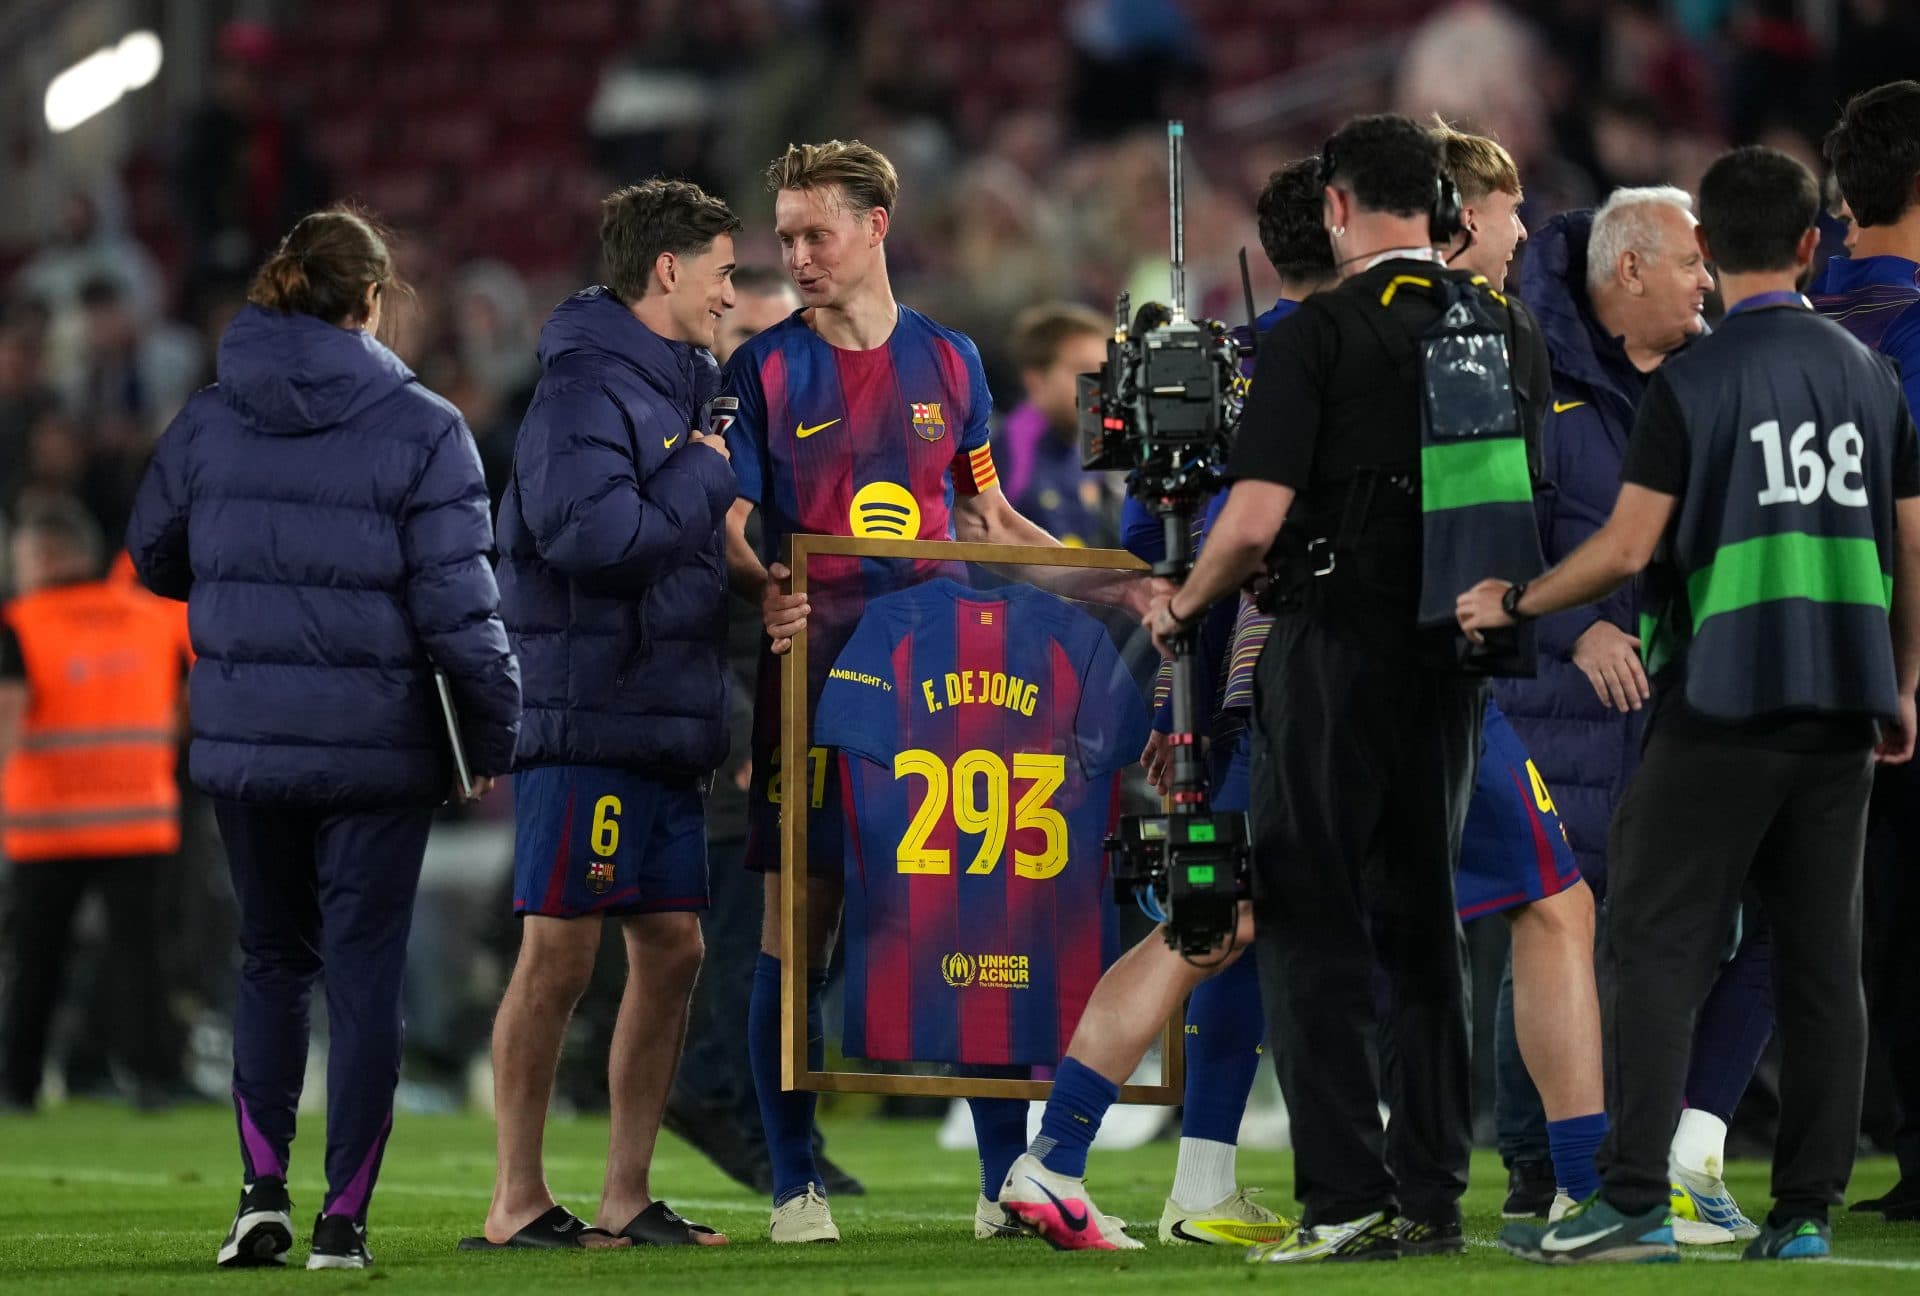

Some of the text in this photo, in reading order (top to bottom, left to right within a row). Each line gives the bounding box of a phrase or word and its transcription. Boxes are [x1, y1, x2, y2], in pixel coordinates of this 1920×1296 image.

[1750, 420, 1868, 507] 168
[829, 668, 892, 691] AMBILIGHT tv
[922, 671, 1039, 716] F. DE JONG
[590, 795, 622, 857] 6
[894, 748, 1069, 880] 293
[979, 955, 1028, 969] UNHCR
[979, 969, 1028, 982] ACNUR
